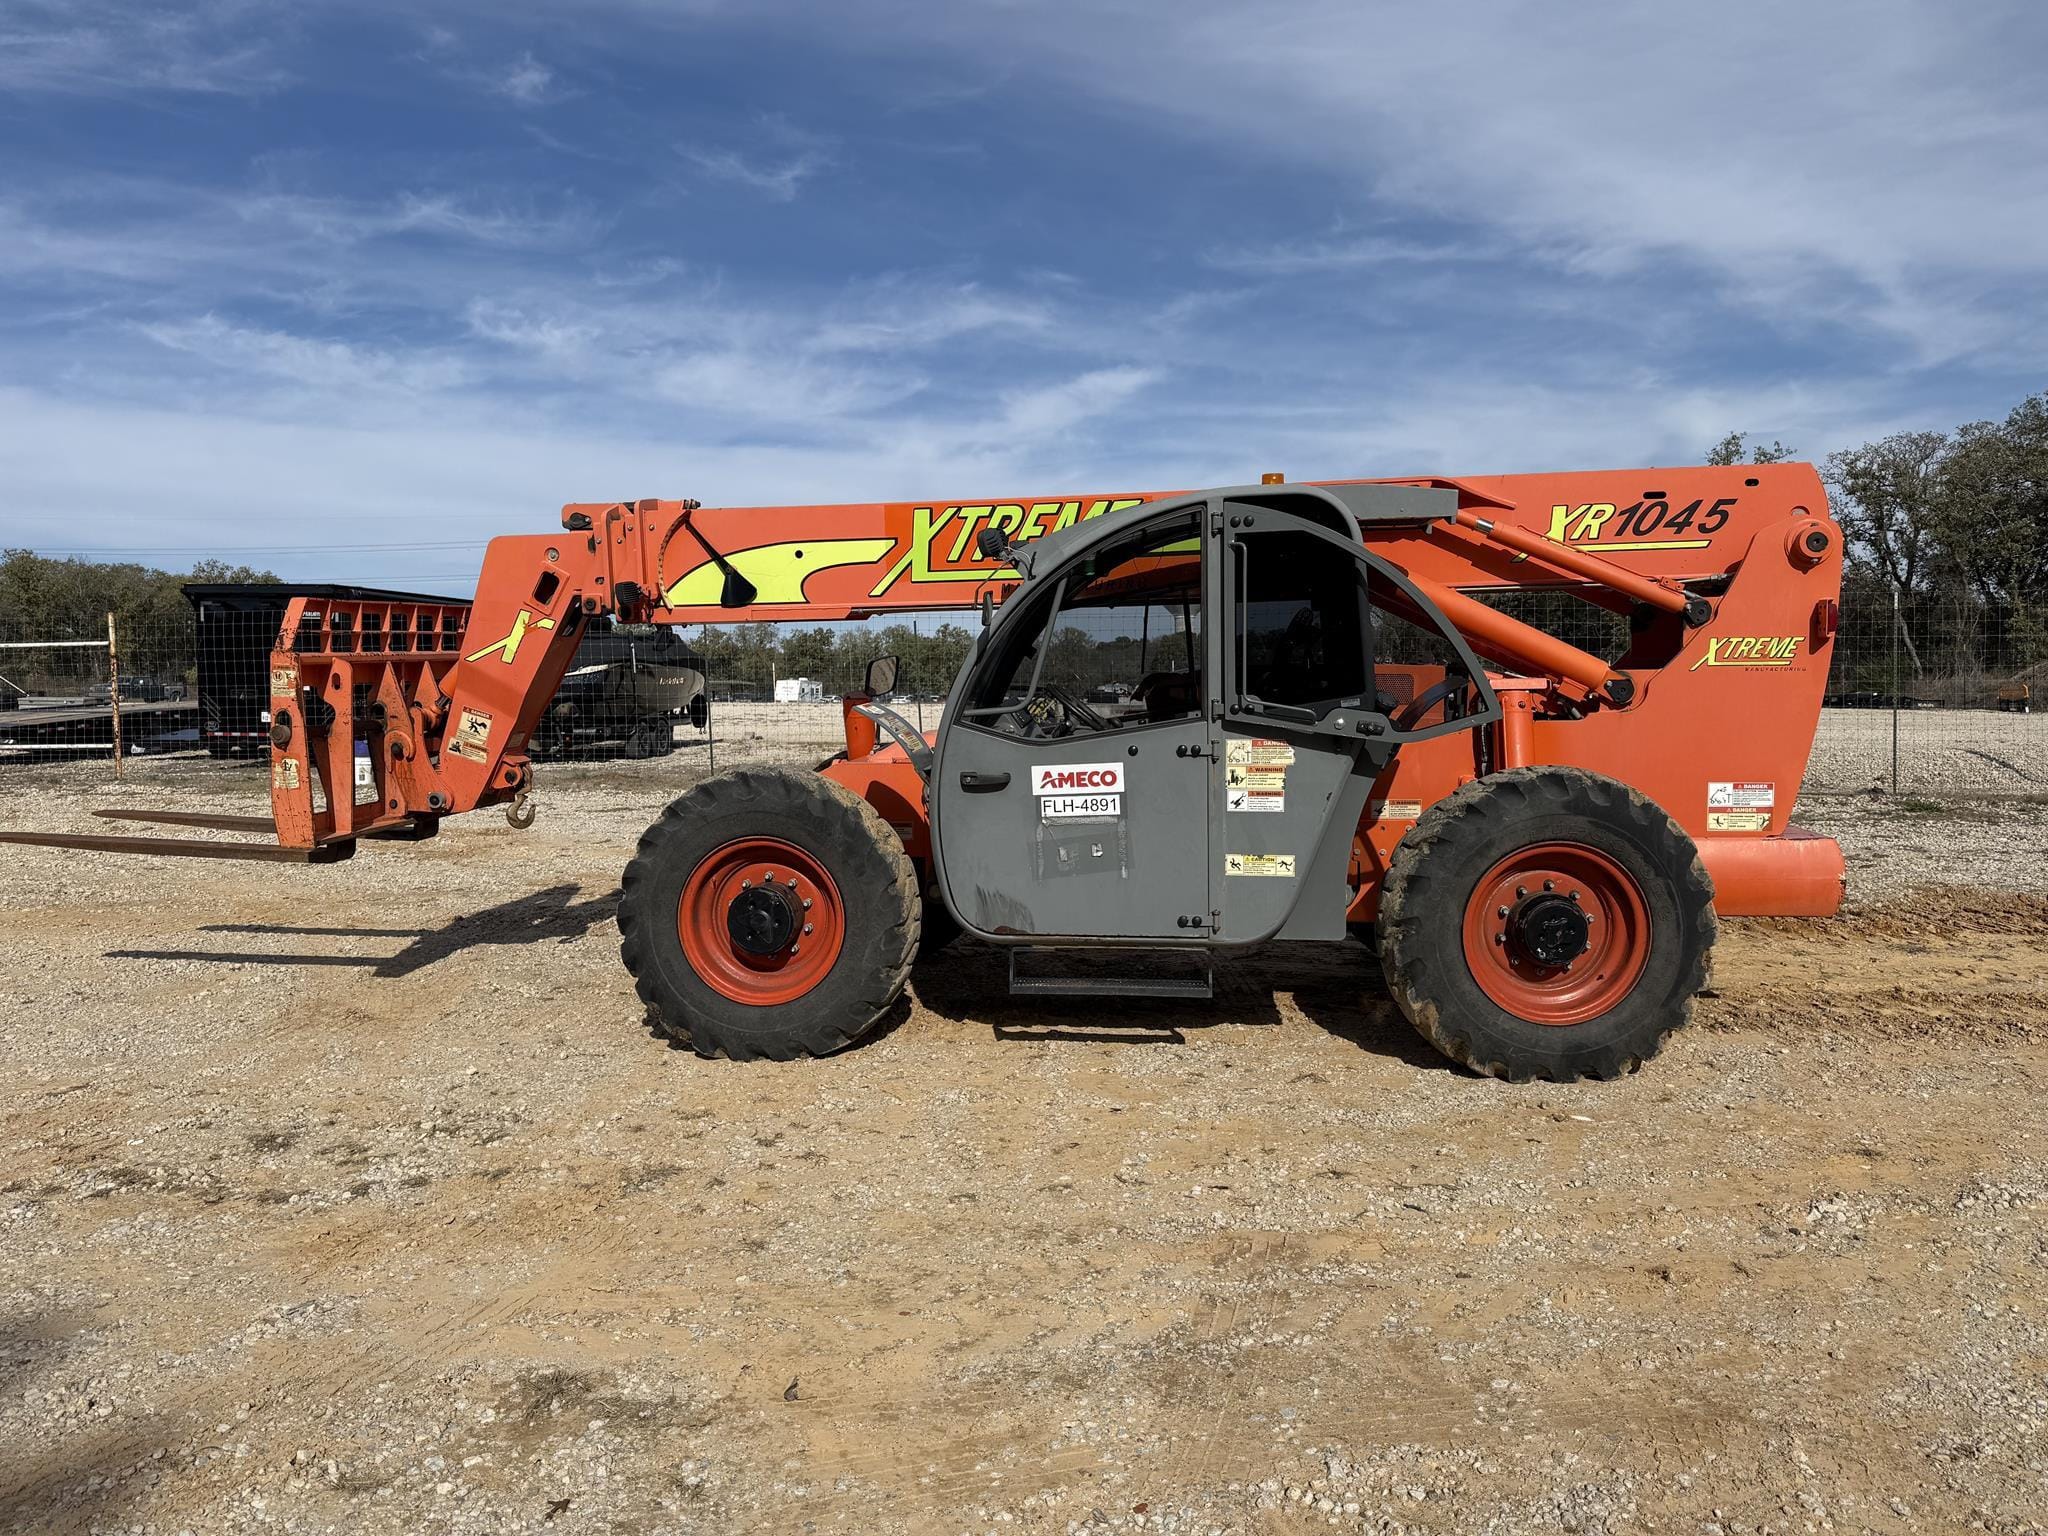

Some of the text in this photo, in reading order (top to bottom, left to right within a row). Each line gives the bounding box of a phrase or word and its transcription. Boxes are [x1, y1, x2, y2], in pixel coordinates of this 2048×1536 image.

[1689, 636, 1806, 671] XTREME
[1040, 770, 1117, 788] AMECO
[1043, 798, 1117, 813] FLH-4891
